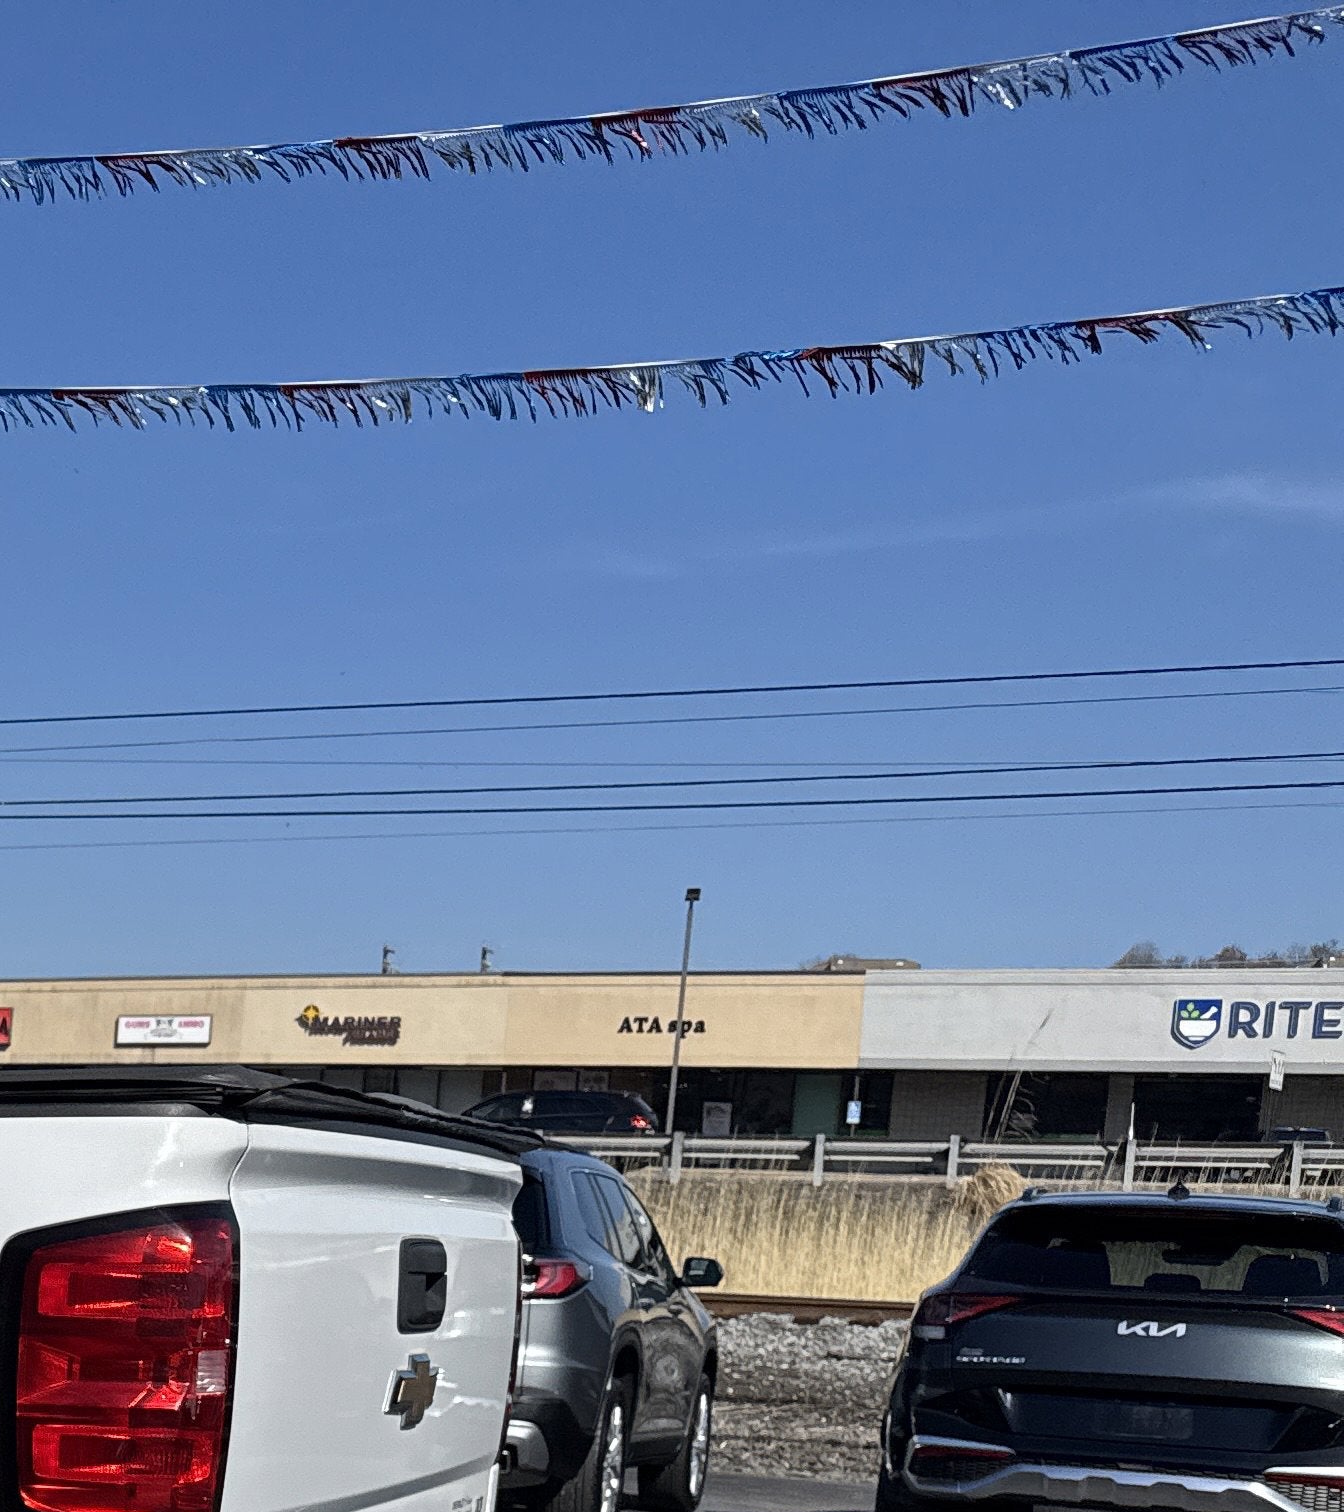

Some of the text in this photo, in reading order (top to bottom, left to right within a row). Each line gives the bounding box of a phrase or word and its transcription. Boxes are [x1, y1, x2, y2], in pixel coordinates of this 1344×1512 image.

[617, 1016, 706, 1039] ATA spa
[1227, 1000, 1344, 1040] RITE
[1117, 1320, 1187, 1338] KIA
